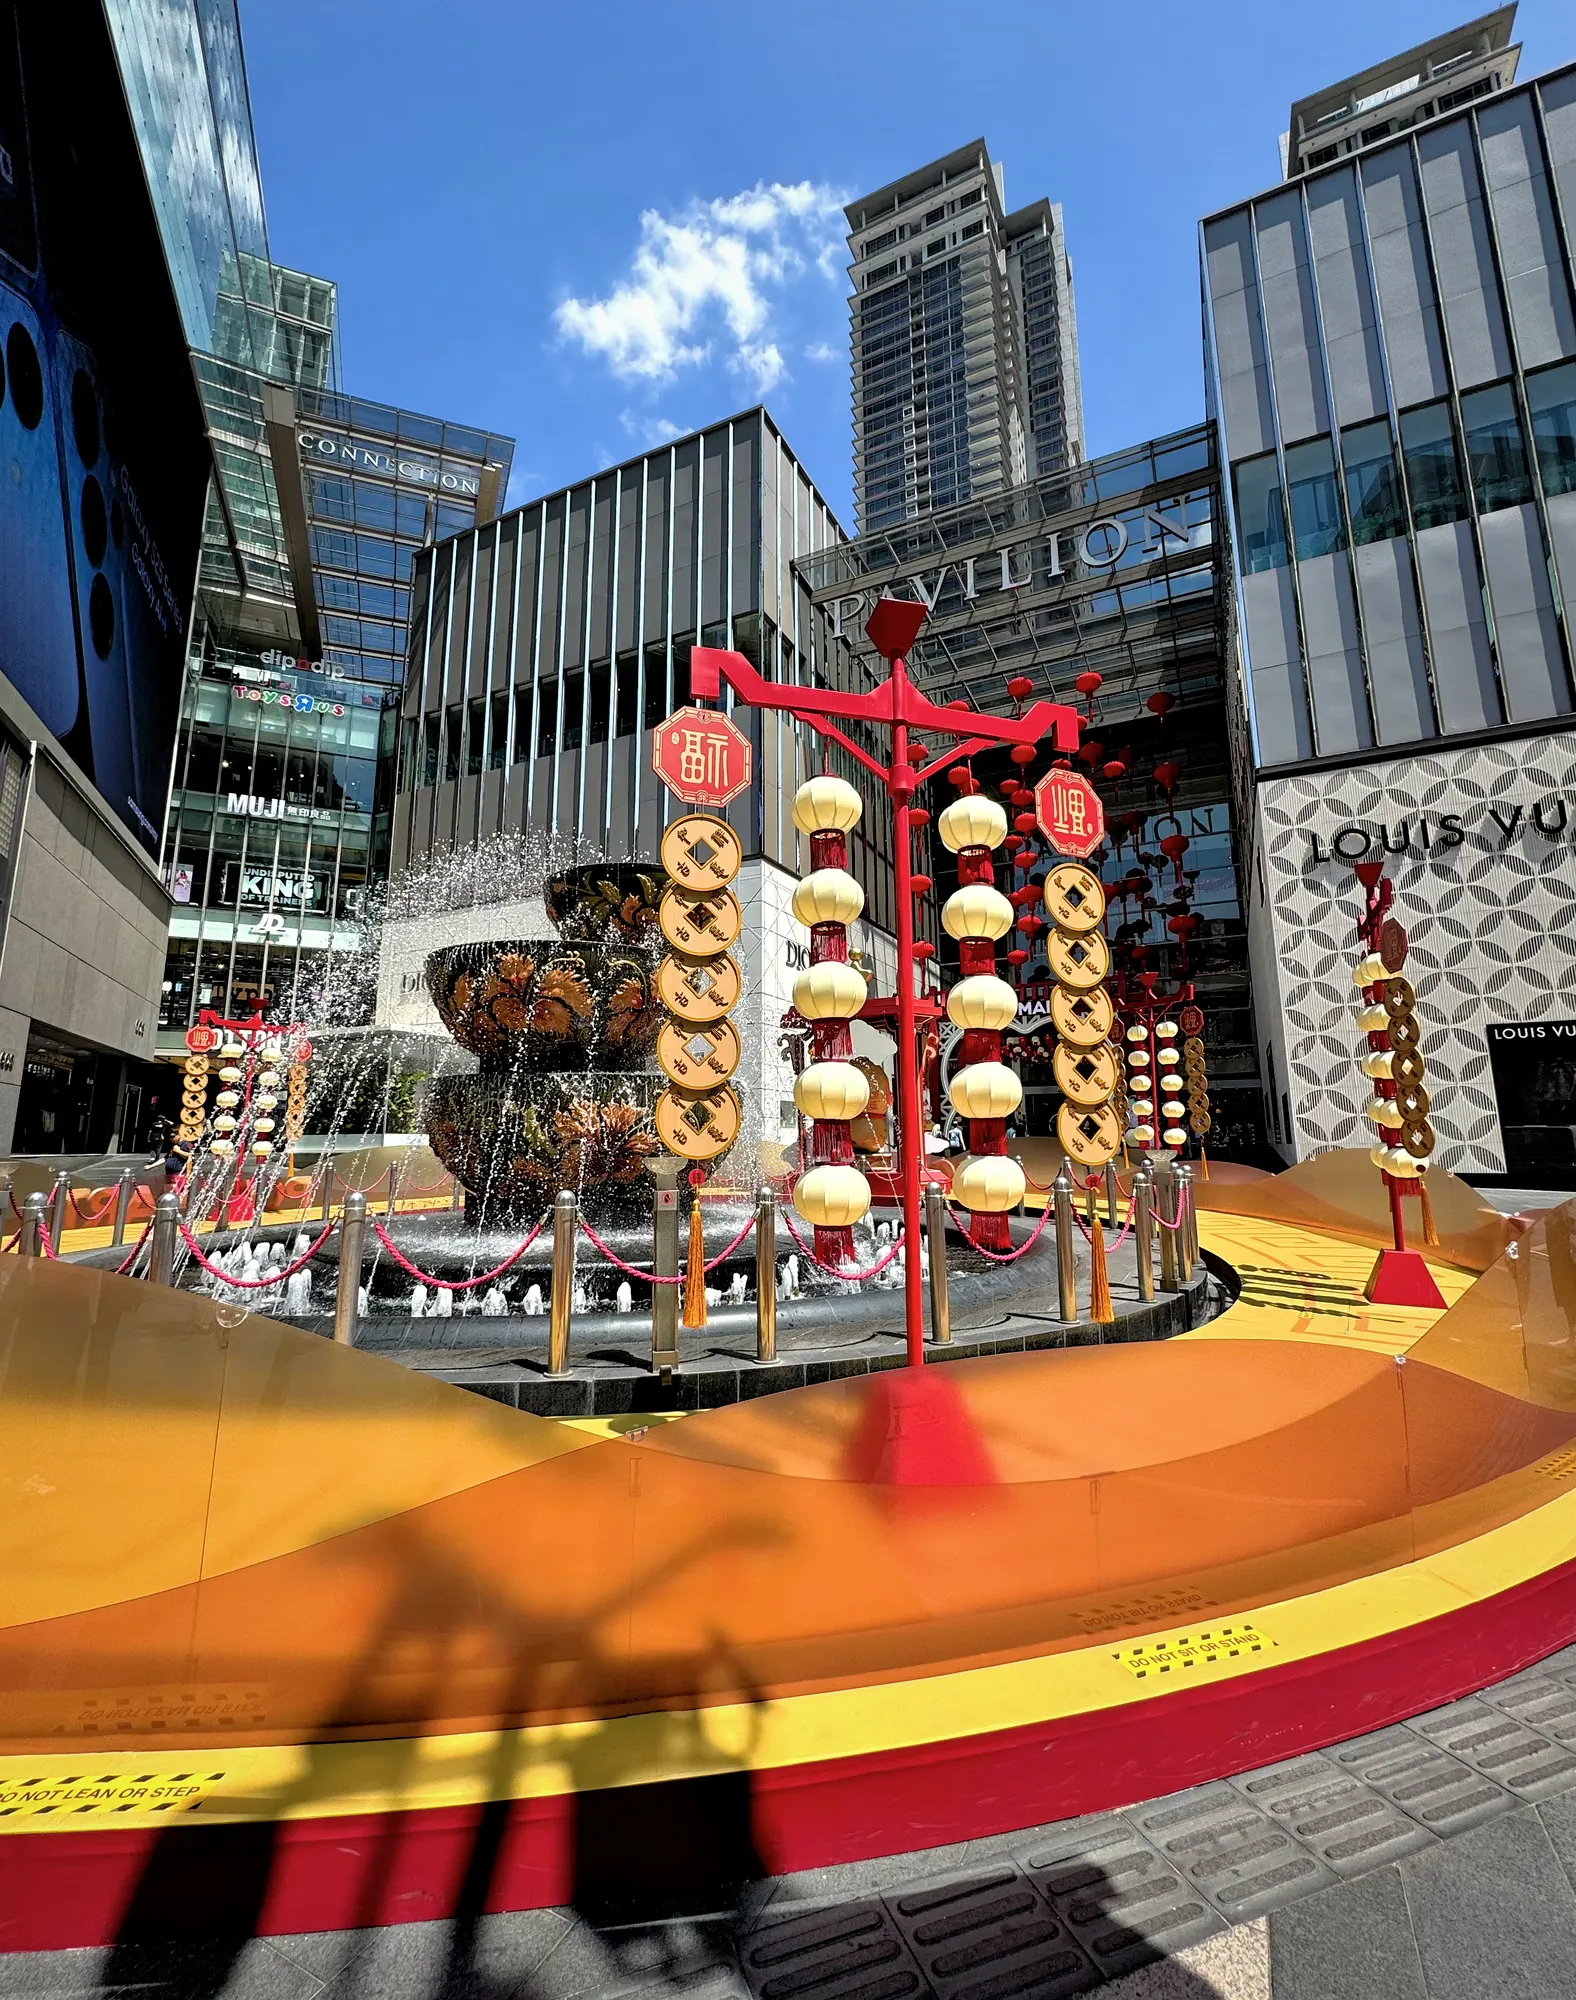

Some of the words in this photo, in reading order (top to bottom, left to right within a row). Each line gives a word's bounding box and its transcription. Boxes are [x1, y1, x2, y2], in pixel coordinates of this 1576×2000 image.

[298, 434, 477, 494] CONNECTION
[827, 494, 1191, 640] PVILION
[227, 792, 285, 819] MUJI
[287, 806, 331, 820] 無印良品
[1310, 814, 1465, 864] LOUIS
[1488, 799, 1568, 842] VU
[242, 876, 314, 899] KING
[786, 940, 812, 971] DIO
[1494, 1026, 1546, 1040] LOUIS
[1128, 1657, 1149, 1669] DO
[1149, 1651, 1177, 1665] NOT
[1178, 1646, 1198, 1658] SIT
[1199, 1642, 1220, 1653] OR
[1220, 1633, 1260, 1648] STAND
[18, 1789, 65, 1801] NOT
[65, 1787, 117, 1800] LEAN
[118, 1787, 148, 1799] OR
[150, 1785, 201, 1798] STEP
